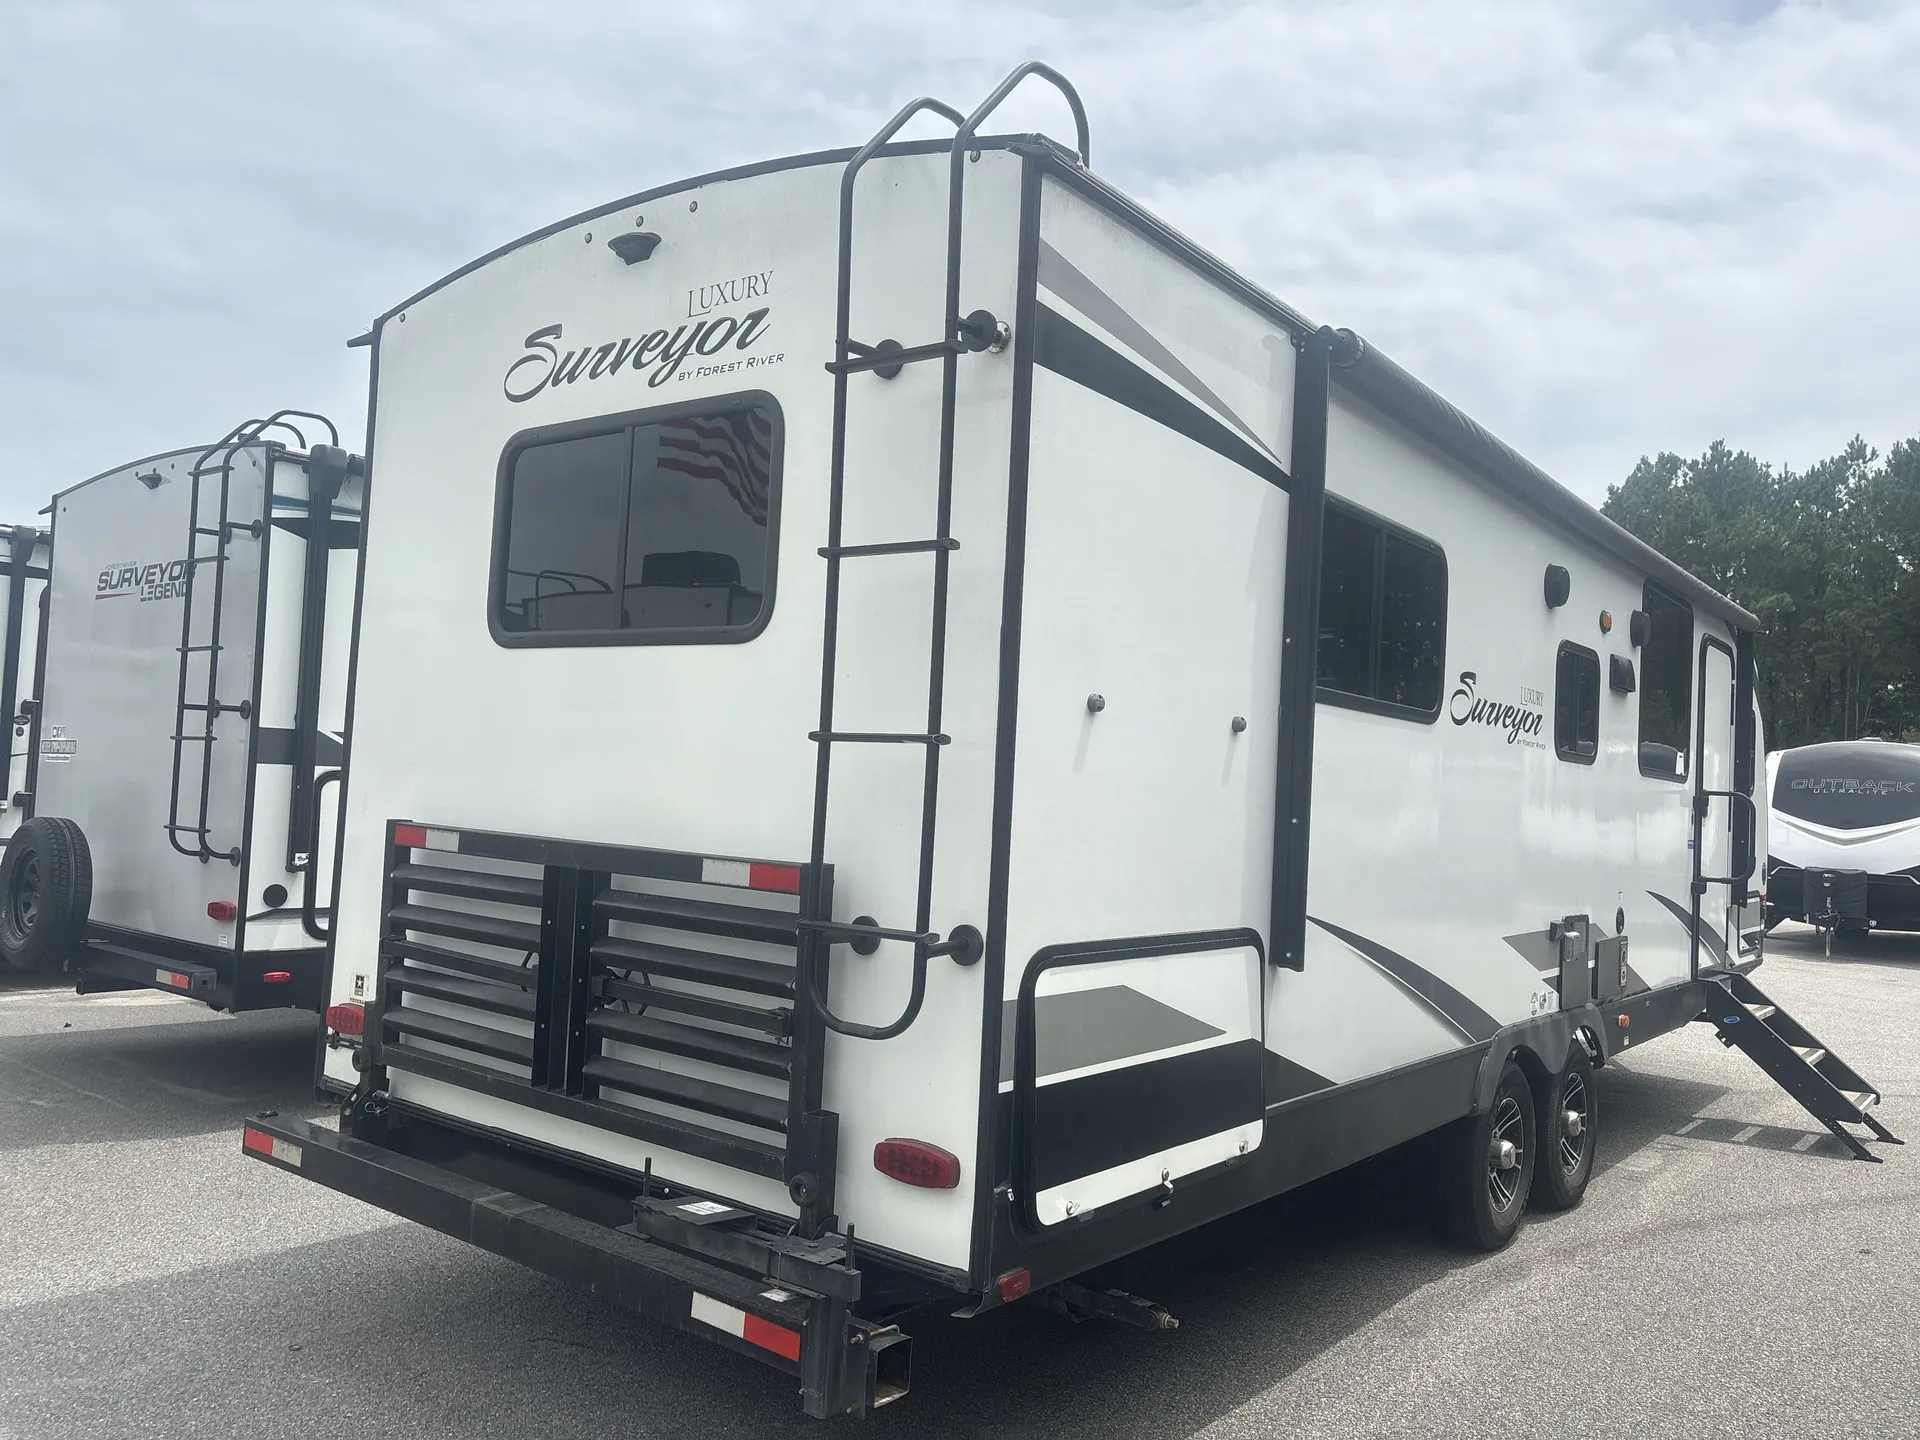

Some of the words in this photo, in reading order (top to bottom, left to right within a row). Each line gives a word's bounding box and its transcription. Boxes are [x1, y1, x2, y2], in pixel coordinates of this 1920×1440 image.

[687, 270, 774, 318] LUXURY
[504, 307, 770, 403] Surveyor
[678, 371, 693, 381] BY
[696, 361, 743, 378] FOREST
[746, 353, 784, 369] RIVER
[1450, 671, 1543, 744] Surveyor
[1520, 686, 1544, 707] LUXURY
[1791, 779, 1916, 793] OUTBACK
